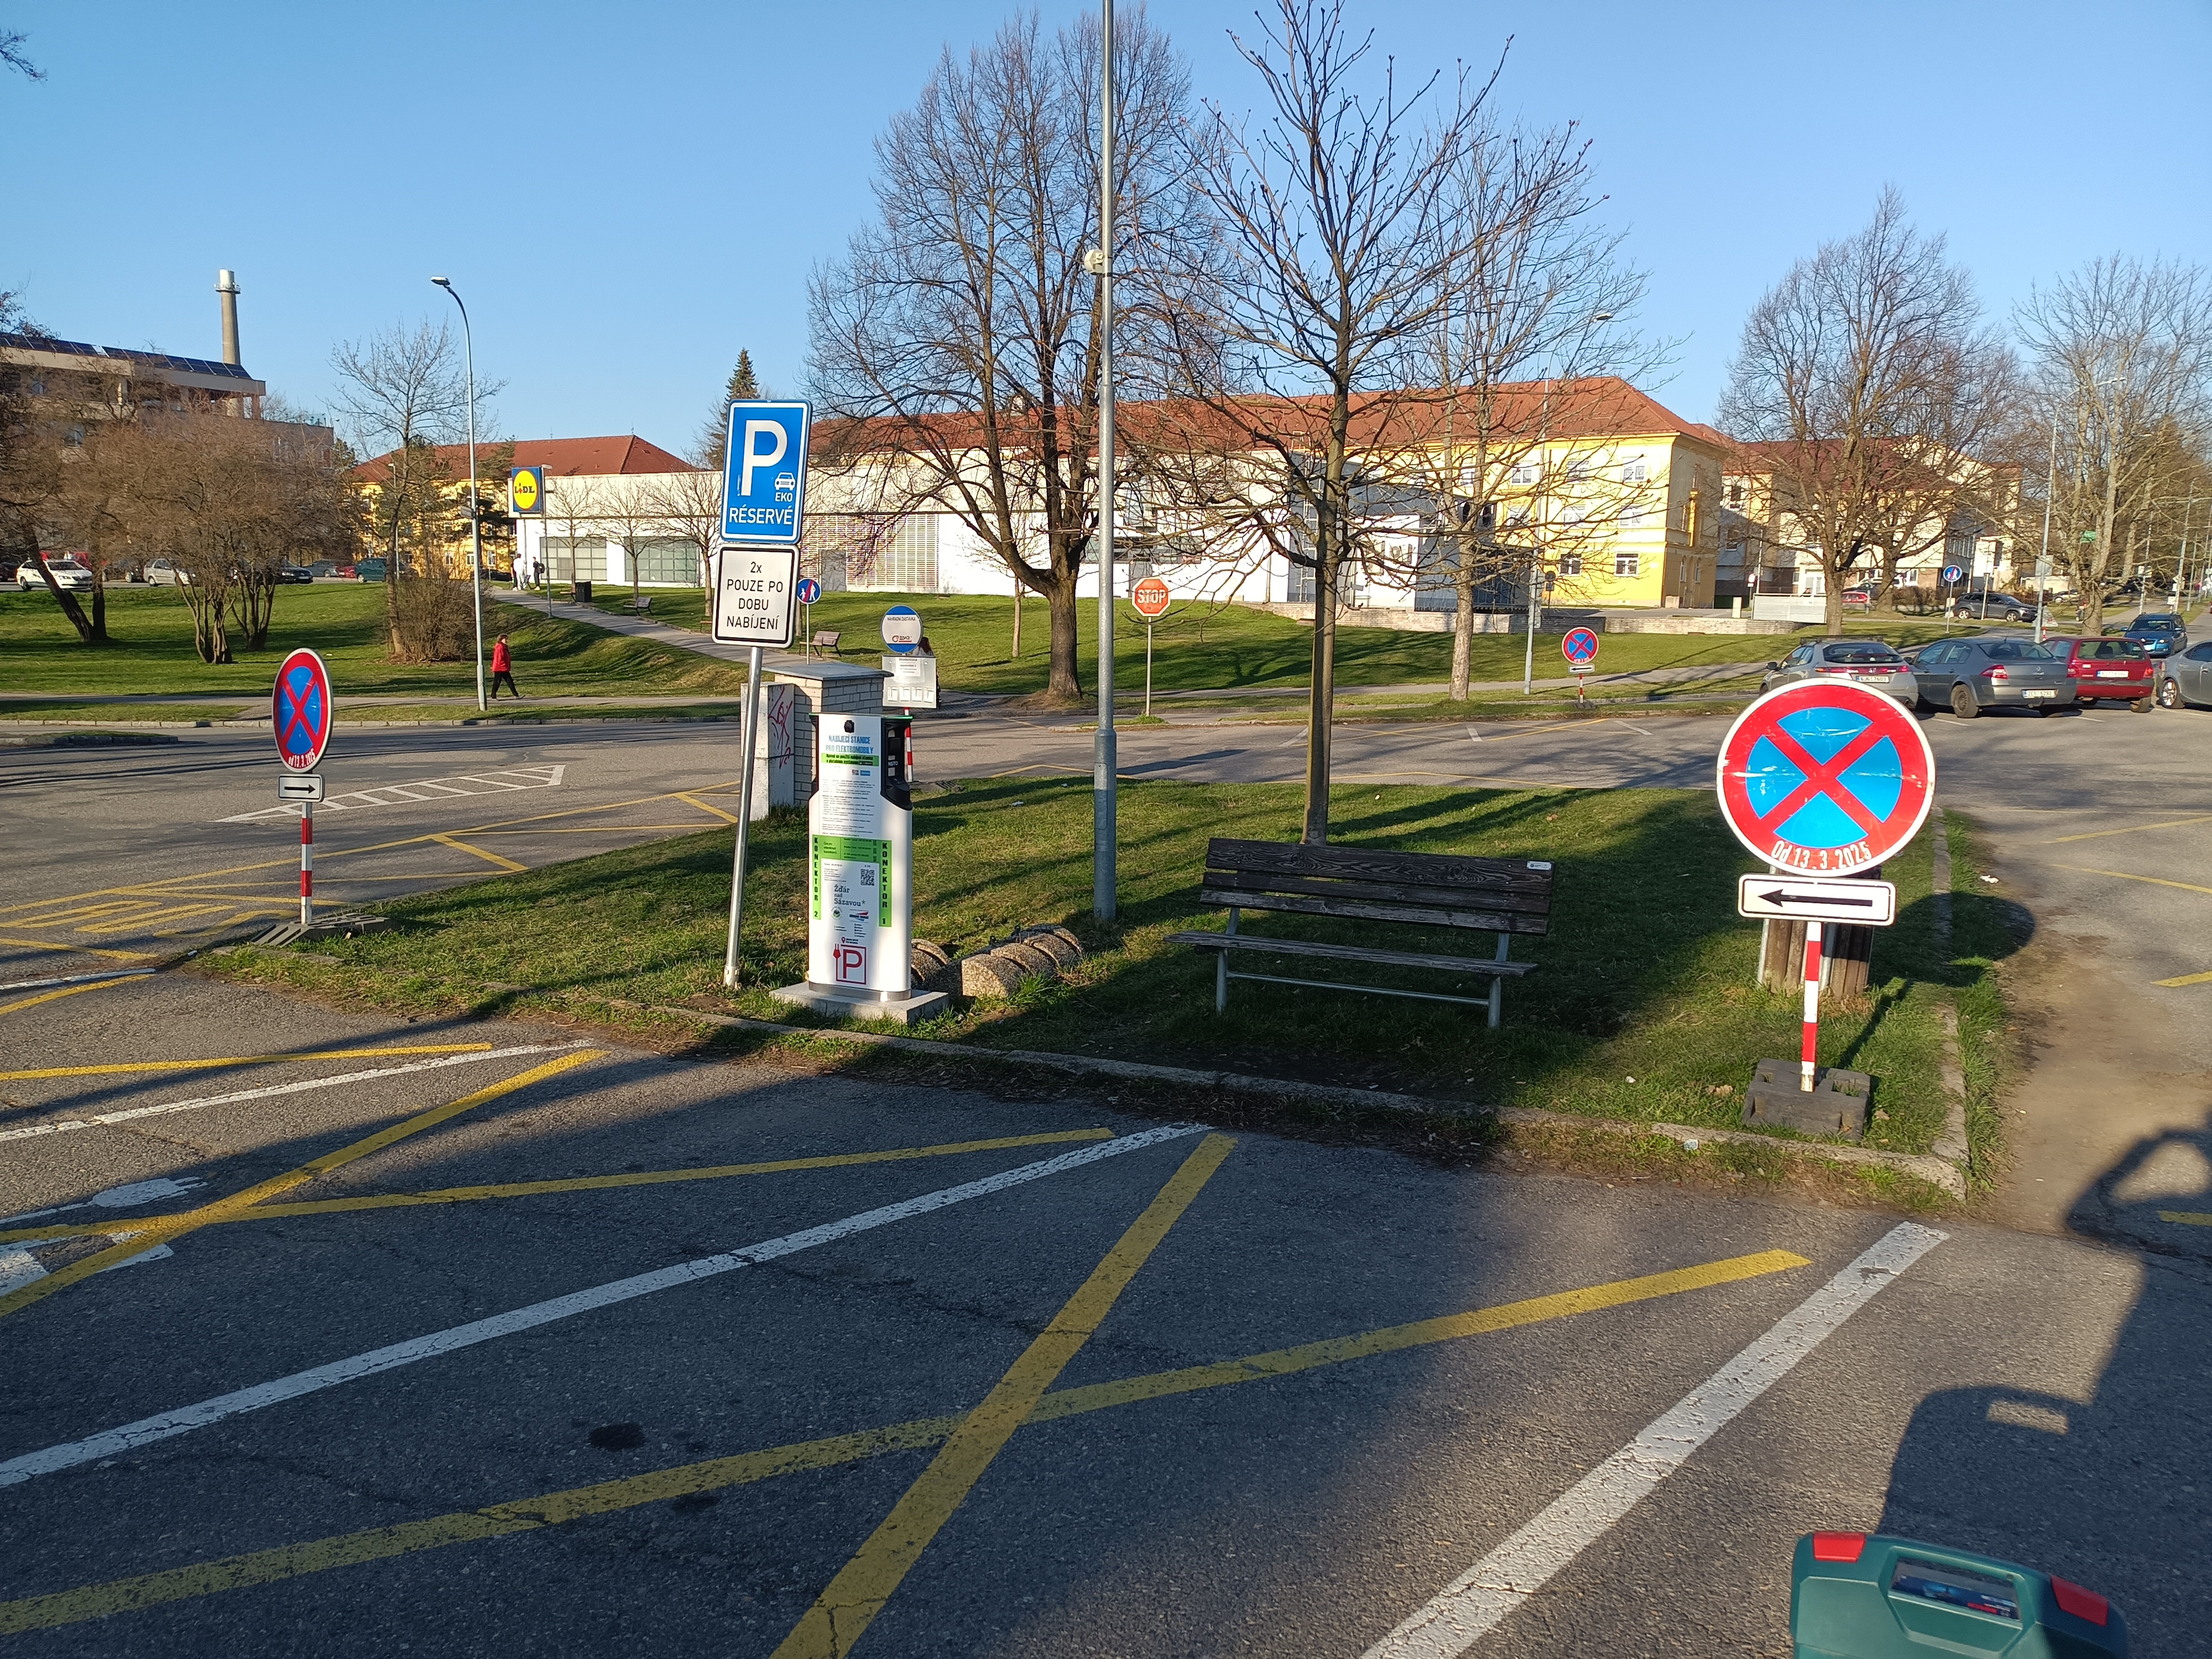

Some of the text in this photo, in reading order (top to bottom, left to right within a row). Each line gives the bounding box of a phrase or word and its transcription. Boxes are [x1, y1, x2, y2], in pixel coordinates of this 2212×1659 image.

[740, 420, 787, 497] P
[775, 492, 793, 502] EKO
[729, 504, 793, 525] RÉSERVÉ
[750, 561, 762, 573] 2x
[727, 579, 783, 593] POUZE PO
[1137, 588, 1166, 604] STOP
[738, 598, 769, 611] DOBU
[727, 613, 779, 630] NABÍJENÍ
[828, 734, 850, 743] NABÍJECÍ
[836, 745, 874, 754] ELEKTROMOBILY
[834, 884, 850, 893] Žďár
[834, 898, 861, 906] Sázavou
[843, 949, 862, 979] P
